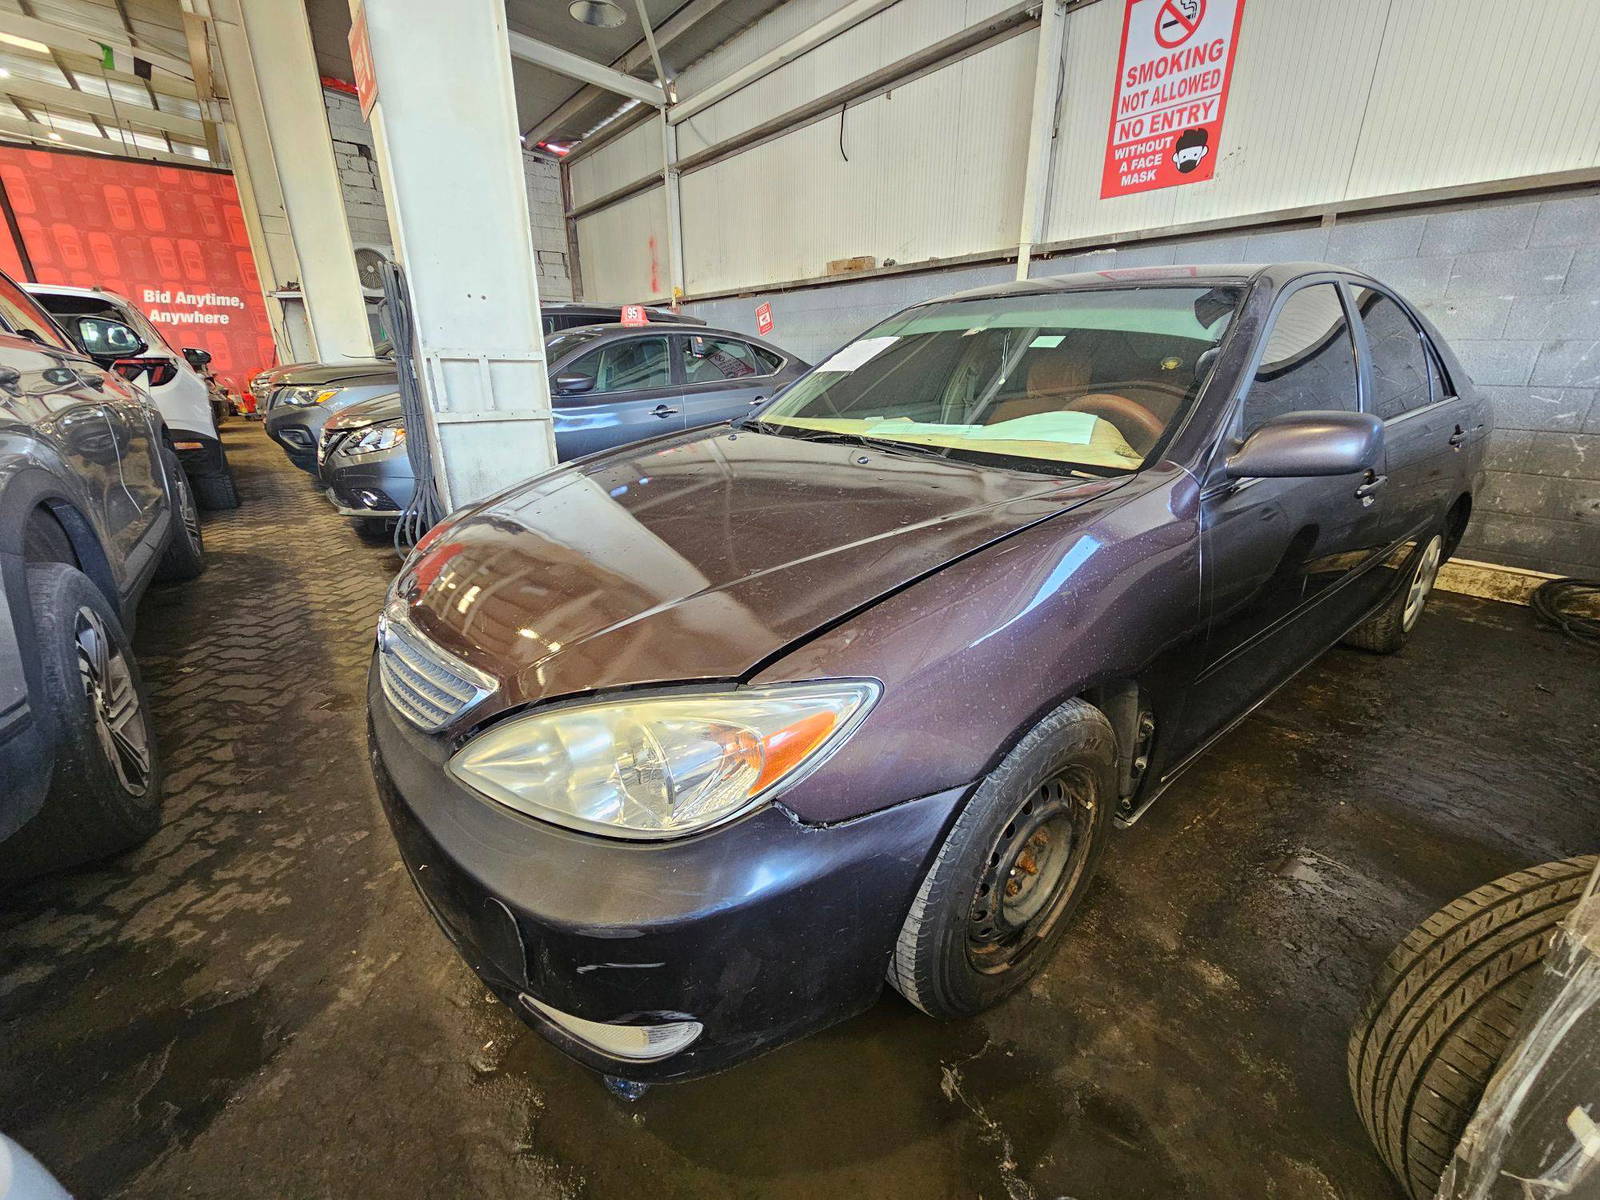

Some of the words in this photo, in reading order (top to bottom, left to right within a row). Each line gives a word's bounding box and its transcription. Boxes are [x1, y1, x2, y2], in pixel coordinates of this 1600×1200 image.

[1126, 39, 1224, 87] SMOKING
[1120, 90, 1149, 115] NOT
[1151, 68, 1221, 106] ALLOWED
[1119, 121, 1144, 141] NO
[1150, 99, 1215, 133] ENTRY
[1115, 137, 1173, 159] WITHOUT
[1120, 162, 1128, 173] A
[1131, 153, 1162, 171] FACE
[1121, 170, 1156, 187] MASK
[143, 289, 171, 304] Bid
[175, 291, 245, 309] Anytime,
[149, 309, 229, 325] Anywhere
